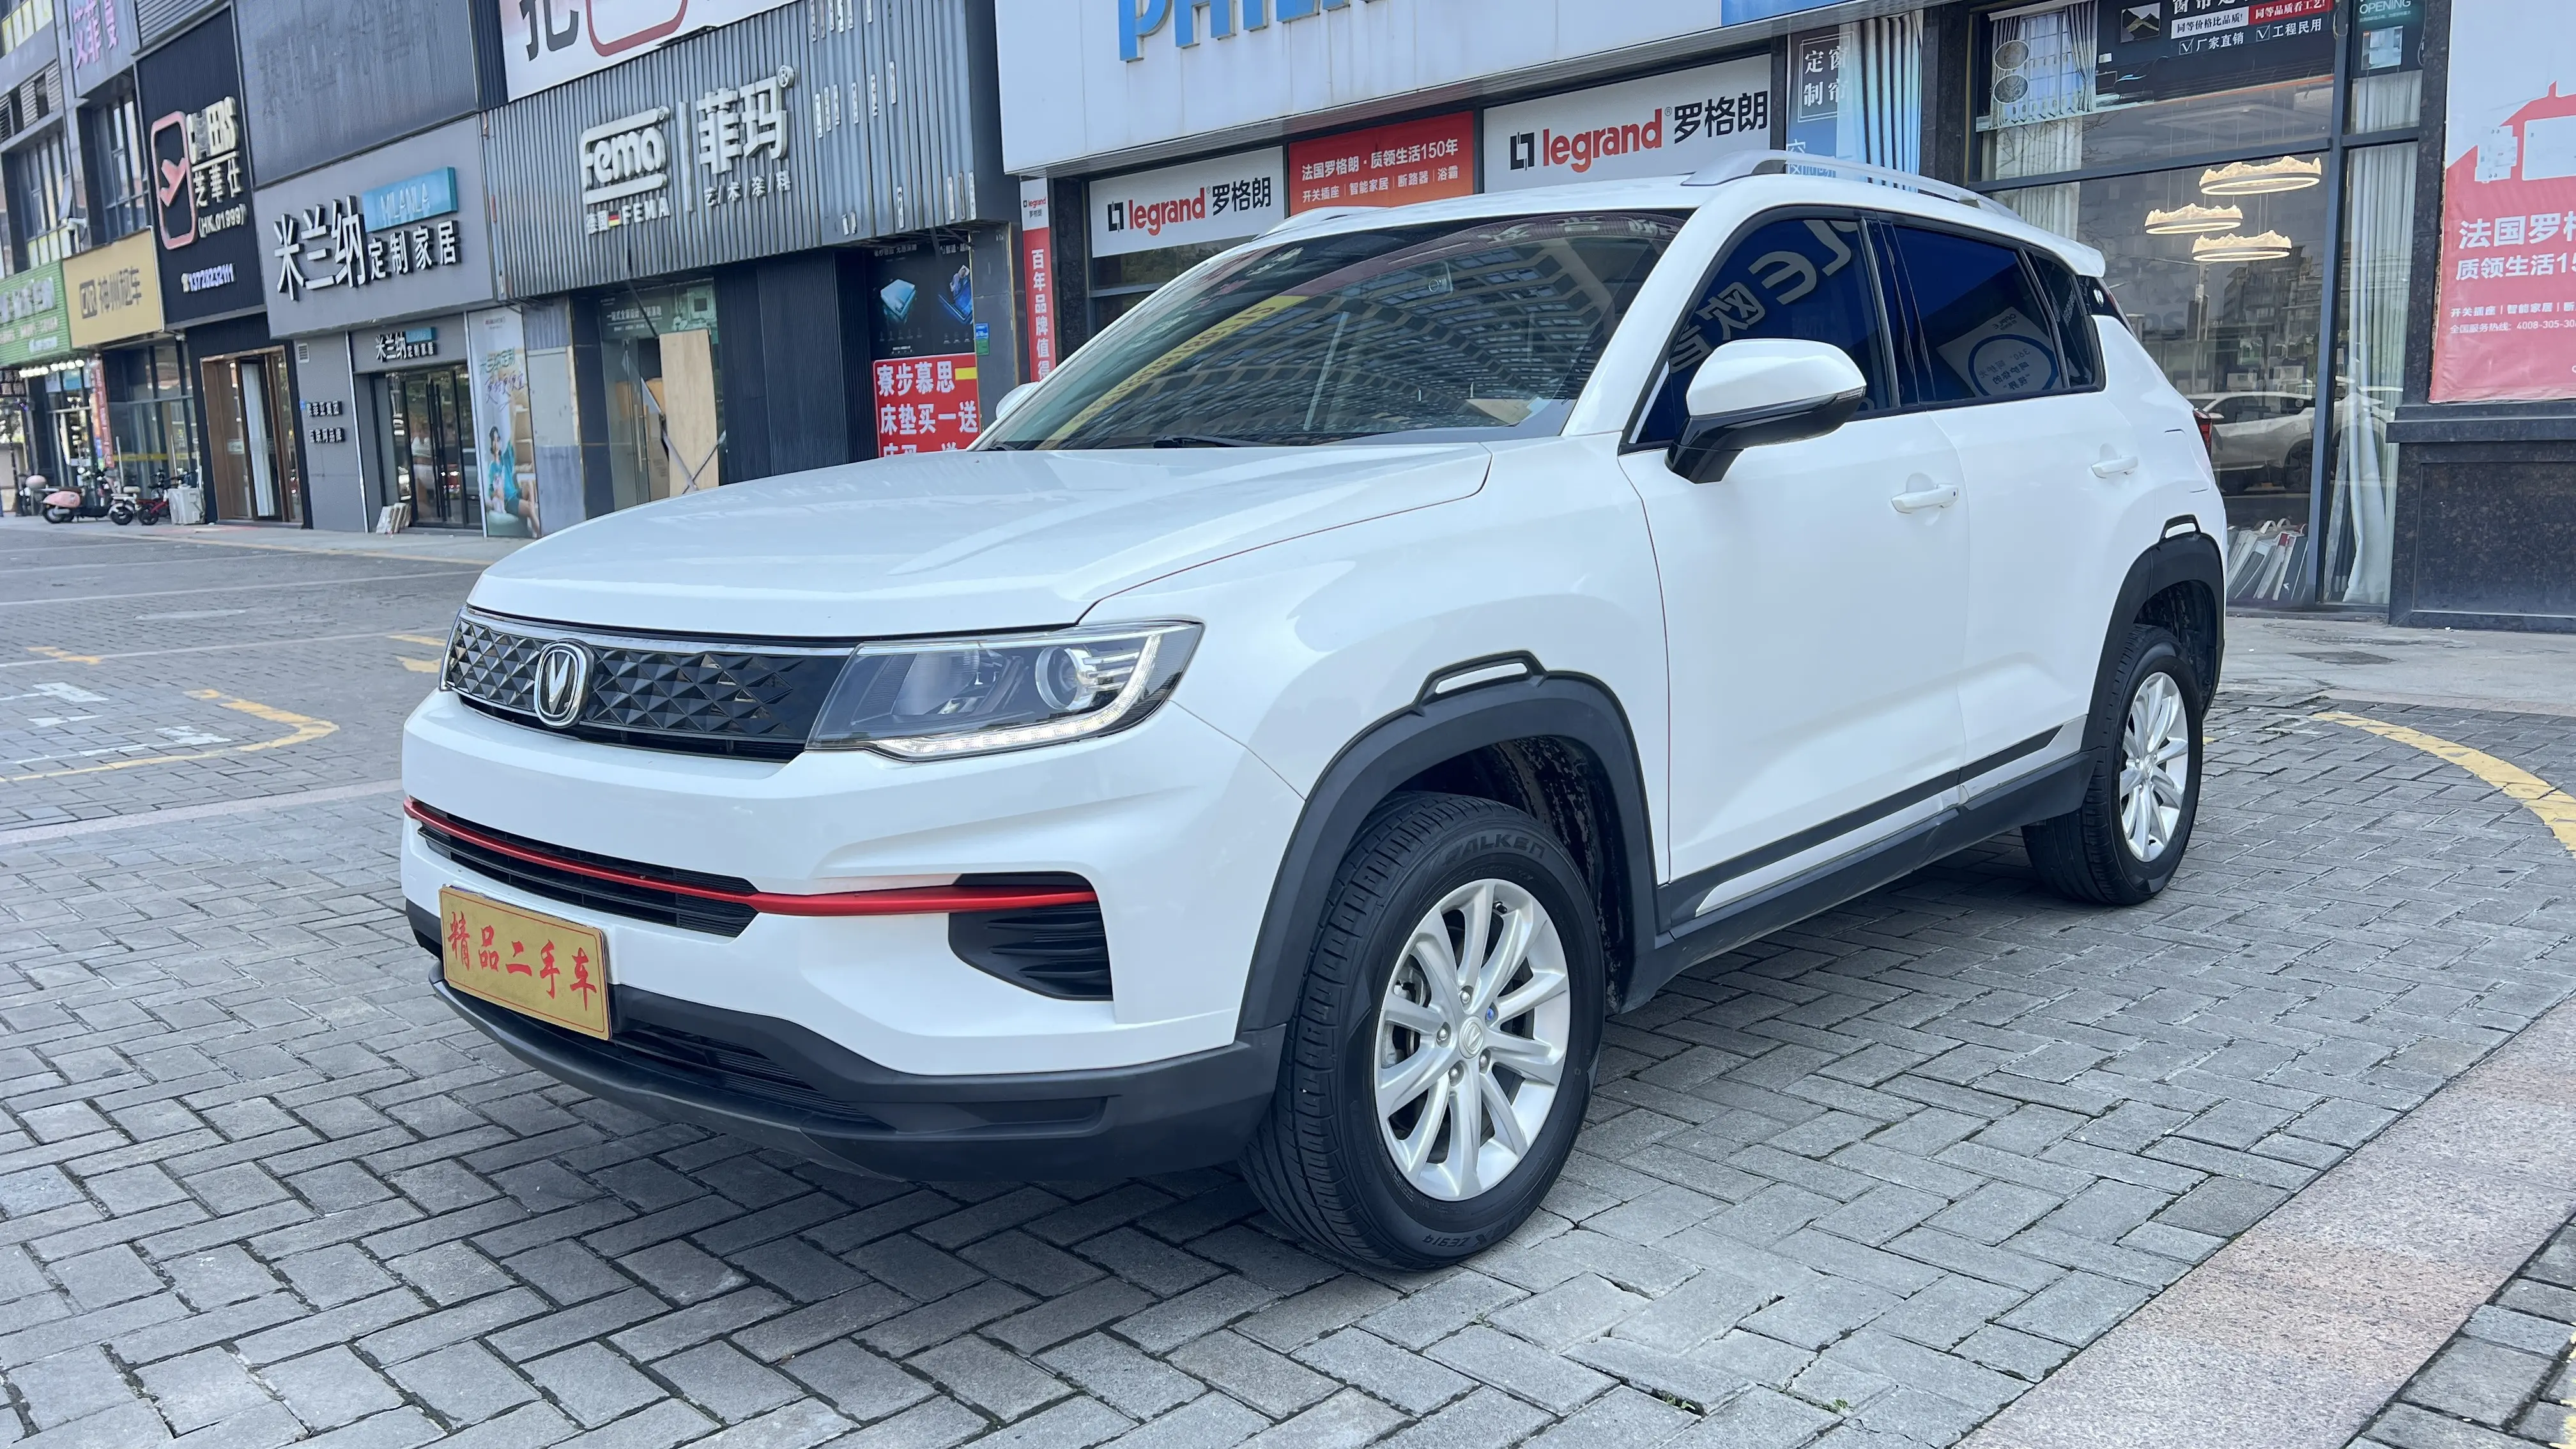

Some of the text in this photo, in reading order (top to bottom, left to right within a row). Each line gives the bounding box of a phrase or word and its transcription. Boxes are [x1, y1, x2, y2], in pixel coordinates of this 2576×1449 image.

[2196, 32, 2244, 51] 厂家直销
[2272, 18, 2322, 38] 工程民用
[696, 76, 788, 174] 菲玛
[1543, 90, 1768, 173] legrand 罗格朗
[1303, 165, 1459, 203] 开关插座 智能家居 断路器 浴霸
[621, 197, 670, 226] FEMA
[1128, 176, 1271, 236] legrand 罗格朗
[273, 194, 366, 302] 米兰纳
[367, 220, 457, 280] 定制家居
[2450, 305, 2496, 318] 开关插座
[2506, 302, 2553, 314] 智能家居
[2516, 319, 2576, 330] 4008-305-30
[880, 400, 978, 436] 床垫买一送
[1442, 834, 1546, 866] FALKEN
[448, 910, 597, 1011] 精品二手车
